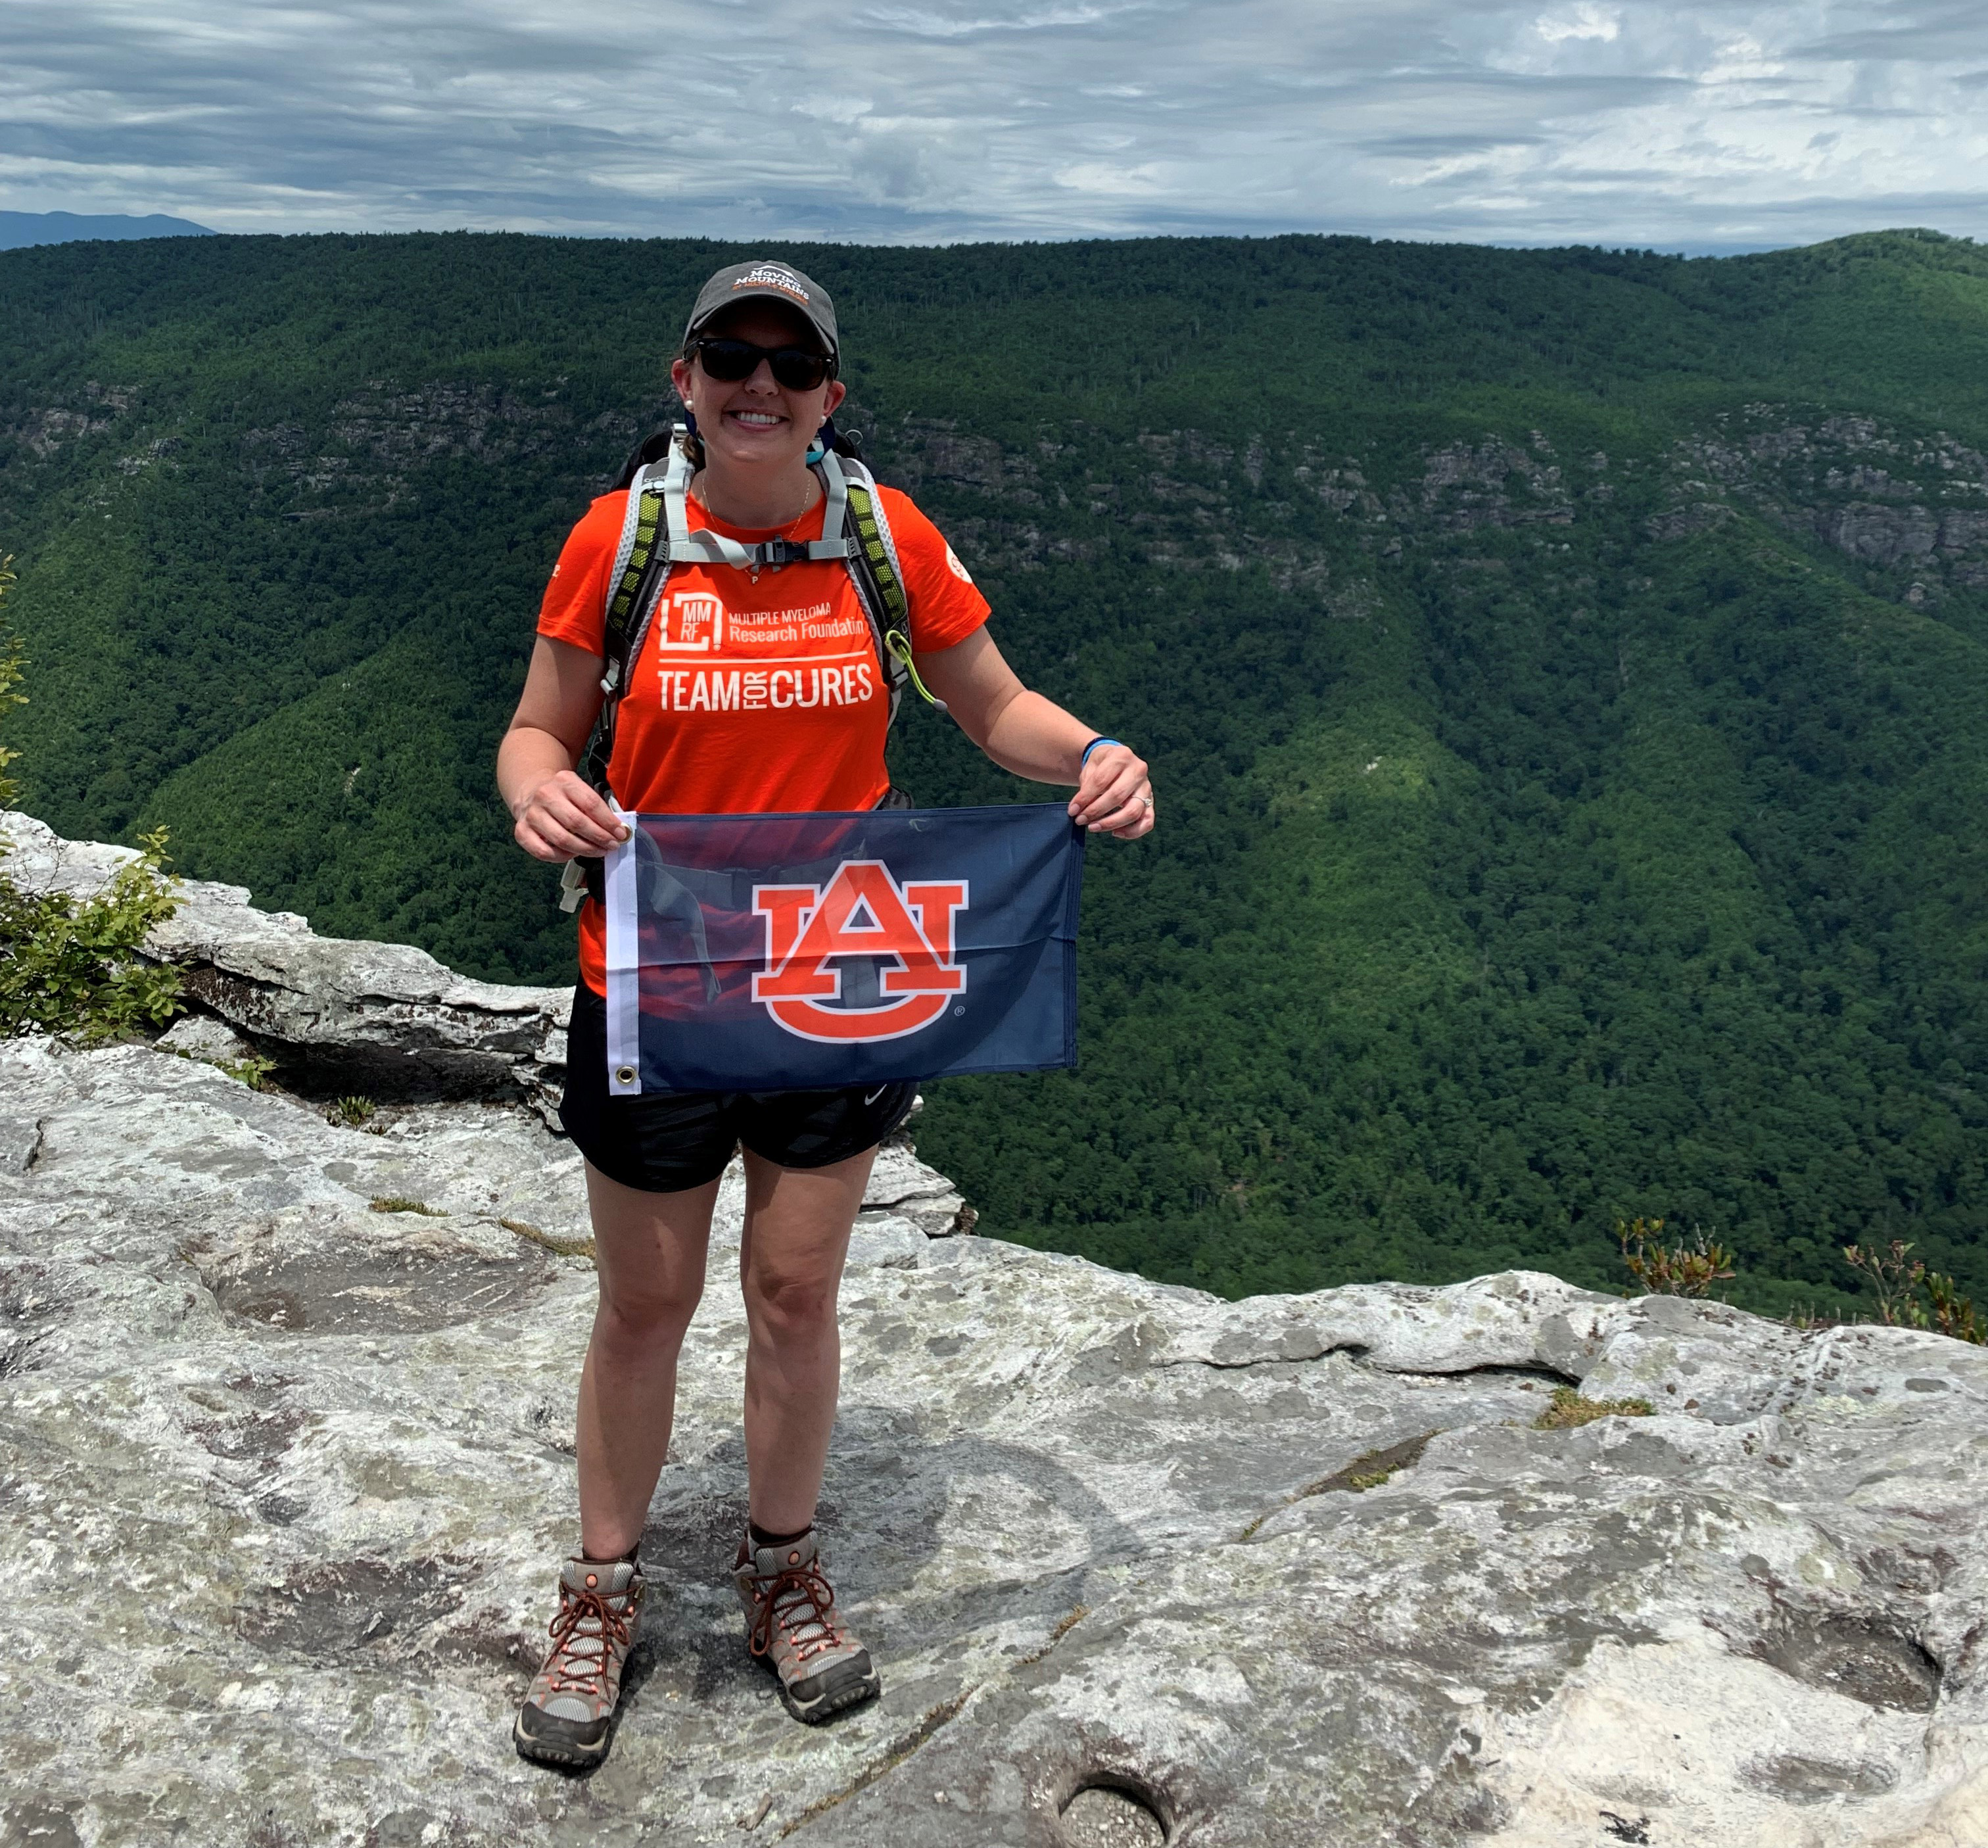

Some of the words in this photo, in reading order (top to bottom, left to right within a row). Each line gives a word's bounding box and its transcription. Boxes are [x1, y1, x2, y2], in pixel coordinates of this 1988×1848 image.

[734, 276, 809, 300] MOUNTAINS
[749, 270, 801, 288] MOVING
[683, 601, 711, 623] MM
[728, 611, 780, 625] MULTIPLE
[782, 602, 831, 623] MYELOMA
[680, 622, 700, 641] RF
[730, 625, 797, 642] Research
[801, 617, 864, 639] Foundatin
[657, 671, 740, 711] TEAM
[743, 671, 768, 710] FOR
[770, 663, 873, 709] CURES
